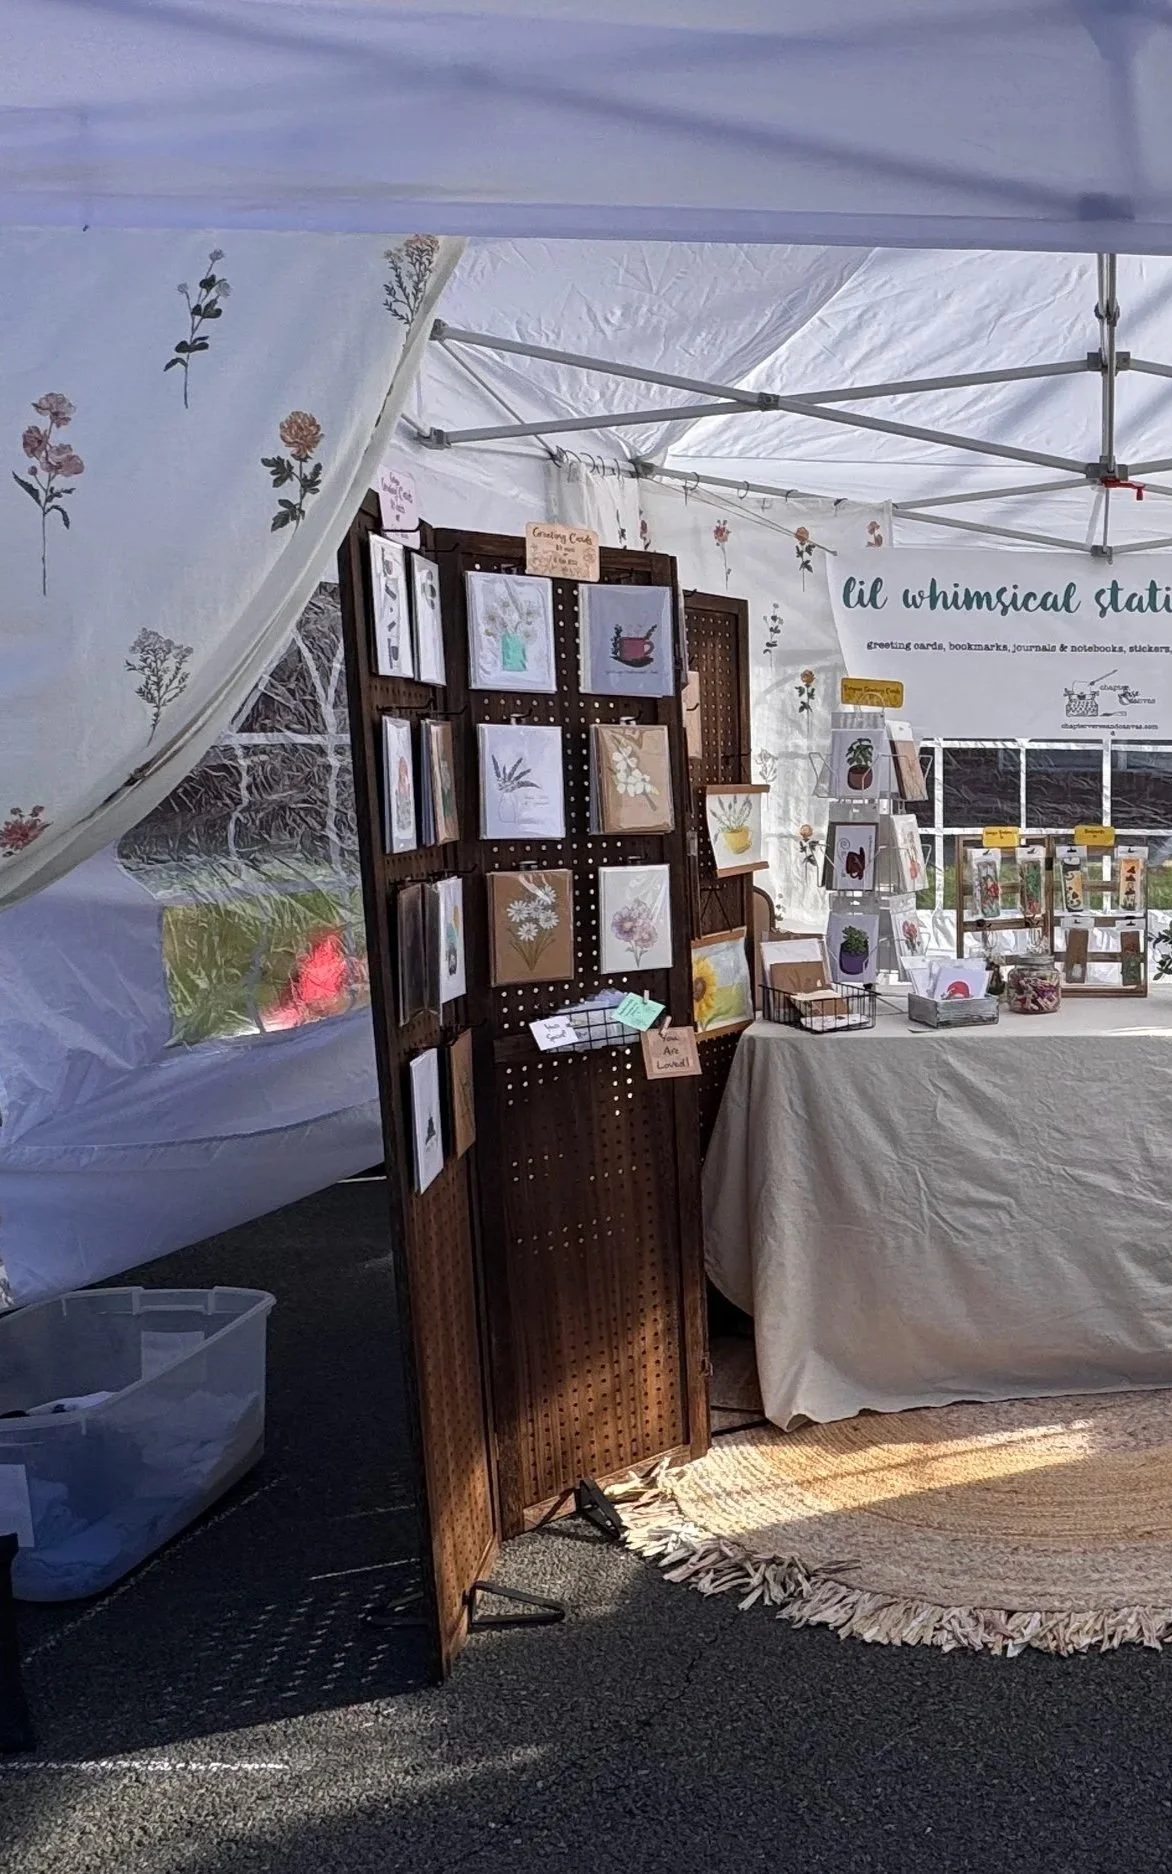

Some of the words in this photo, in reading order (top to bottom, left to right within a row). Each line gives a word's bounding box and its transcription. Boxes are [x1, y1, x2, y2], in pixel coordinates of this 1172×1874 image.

[532, 527, 566, 544] Greeting
[569, 532, 592, 545] Cards
[842, 576, 888, 610] lil
[902, 577, 1081, 617] whimsical
[866, 641, 911, 651] greeting
[913, 641, 946, 652] cards,
[948, 641, 1011, 653] bookmarks,
[1012, 643, 1057, 653] journals
[1059, 644, 1068, 653] &
[1070, 644, 1127, 654] notebooks,
[1128, 644, 1172, 655] stickers,
[663, 1046, 679, 1056] Are
[656, 1057, 690, 1070] Loved!
